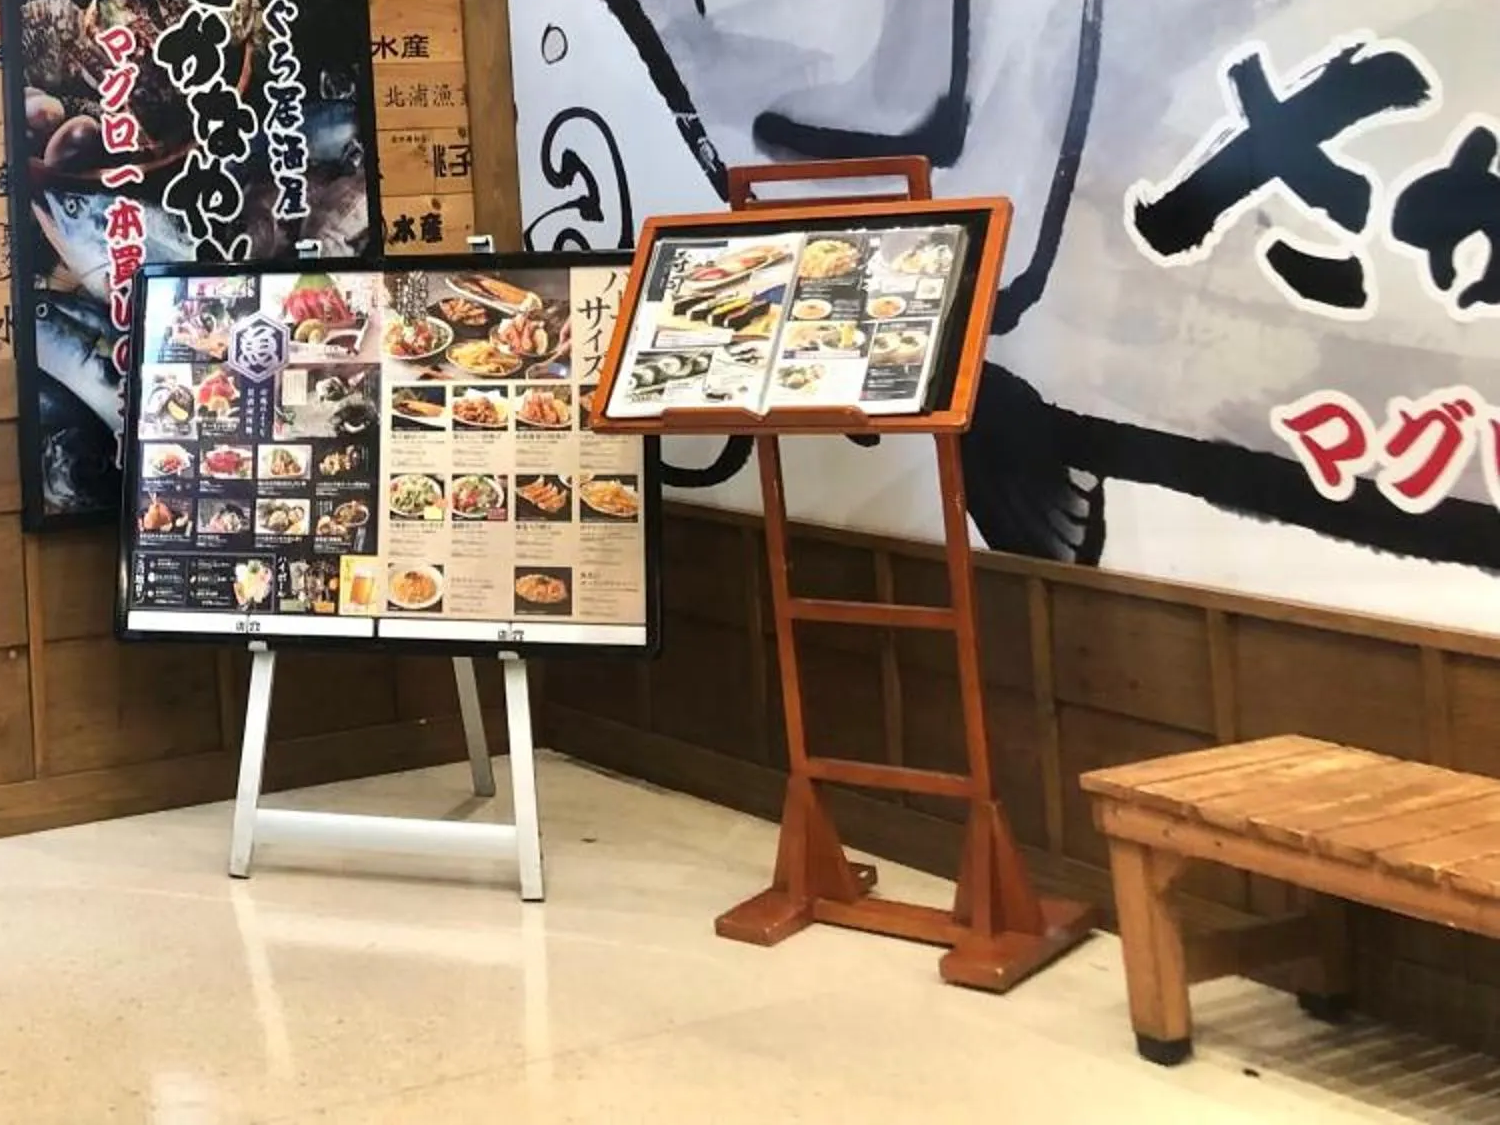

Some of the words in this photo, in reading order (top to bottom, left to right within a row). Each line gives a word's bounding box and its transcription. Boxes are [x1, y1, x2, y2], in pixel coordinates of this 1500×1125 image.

[372, 33, 430, 59] 水産
[388, 213, 442, 243] 水産
[1283, 399, 1500, 499] マグ
